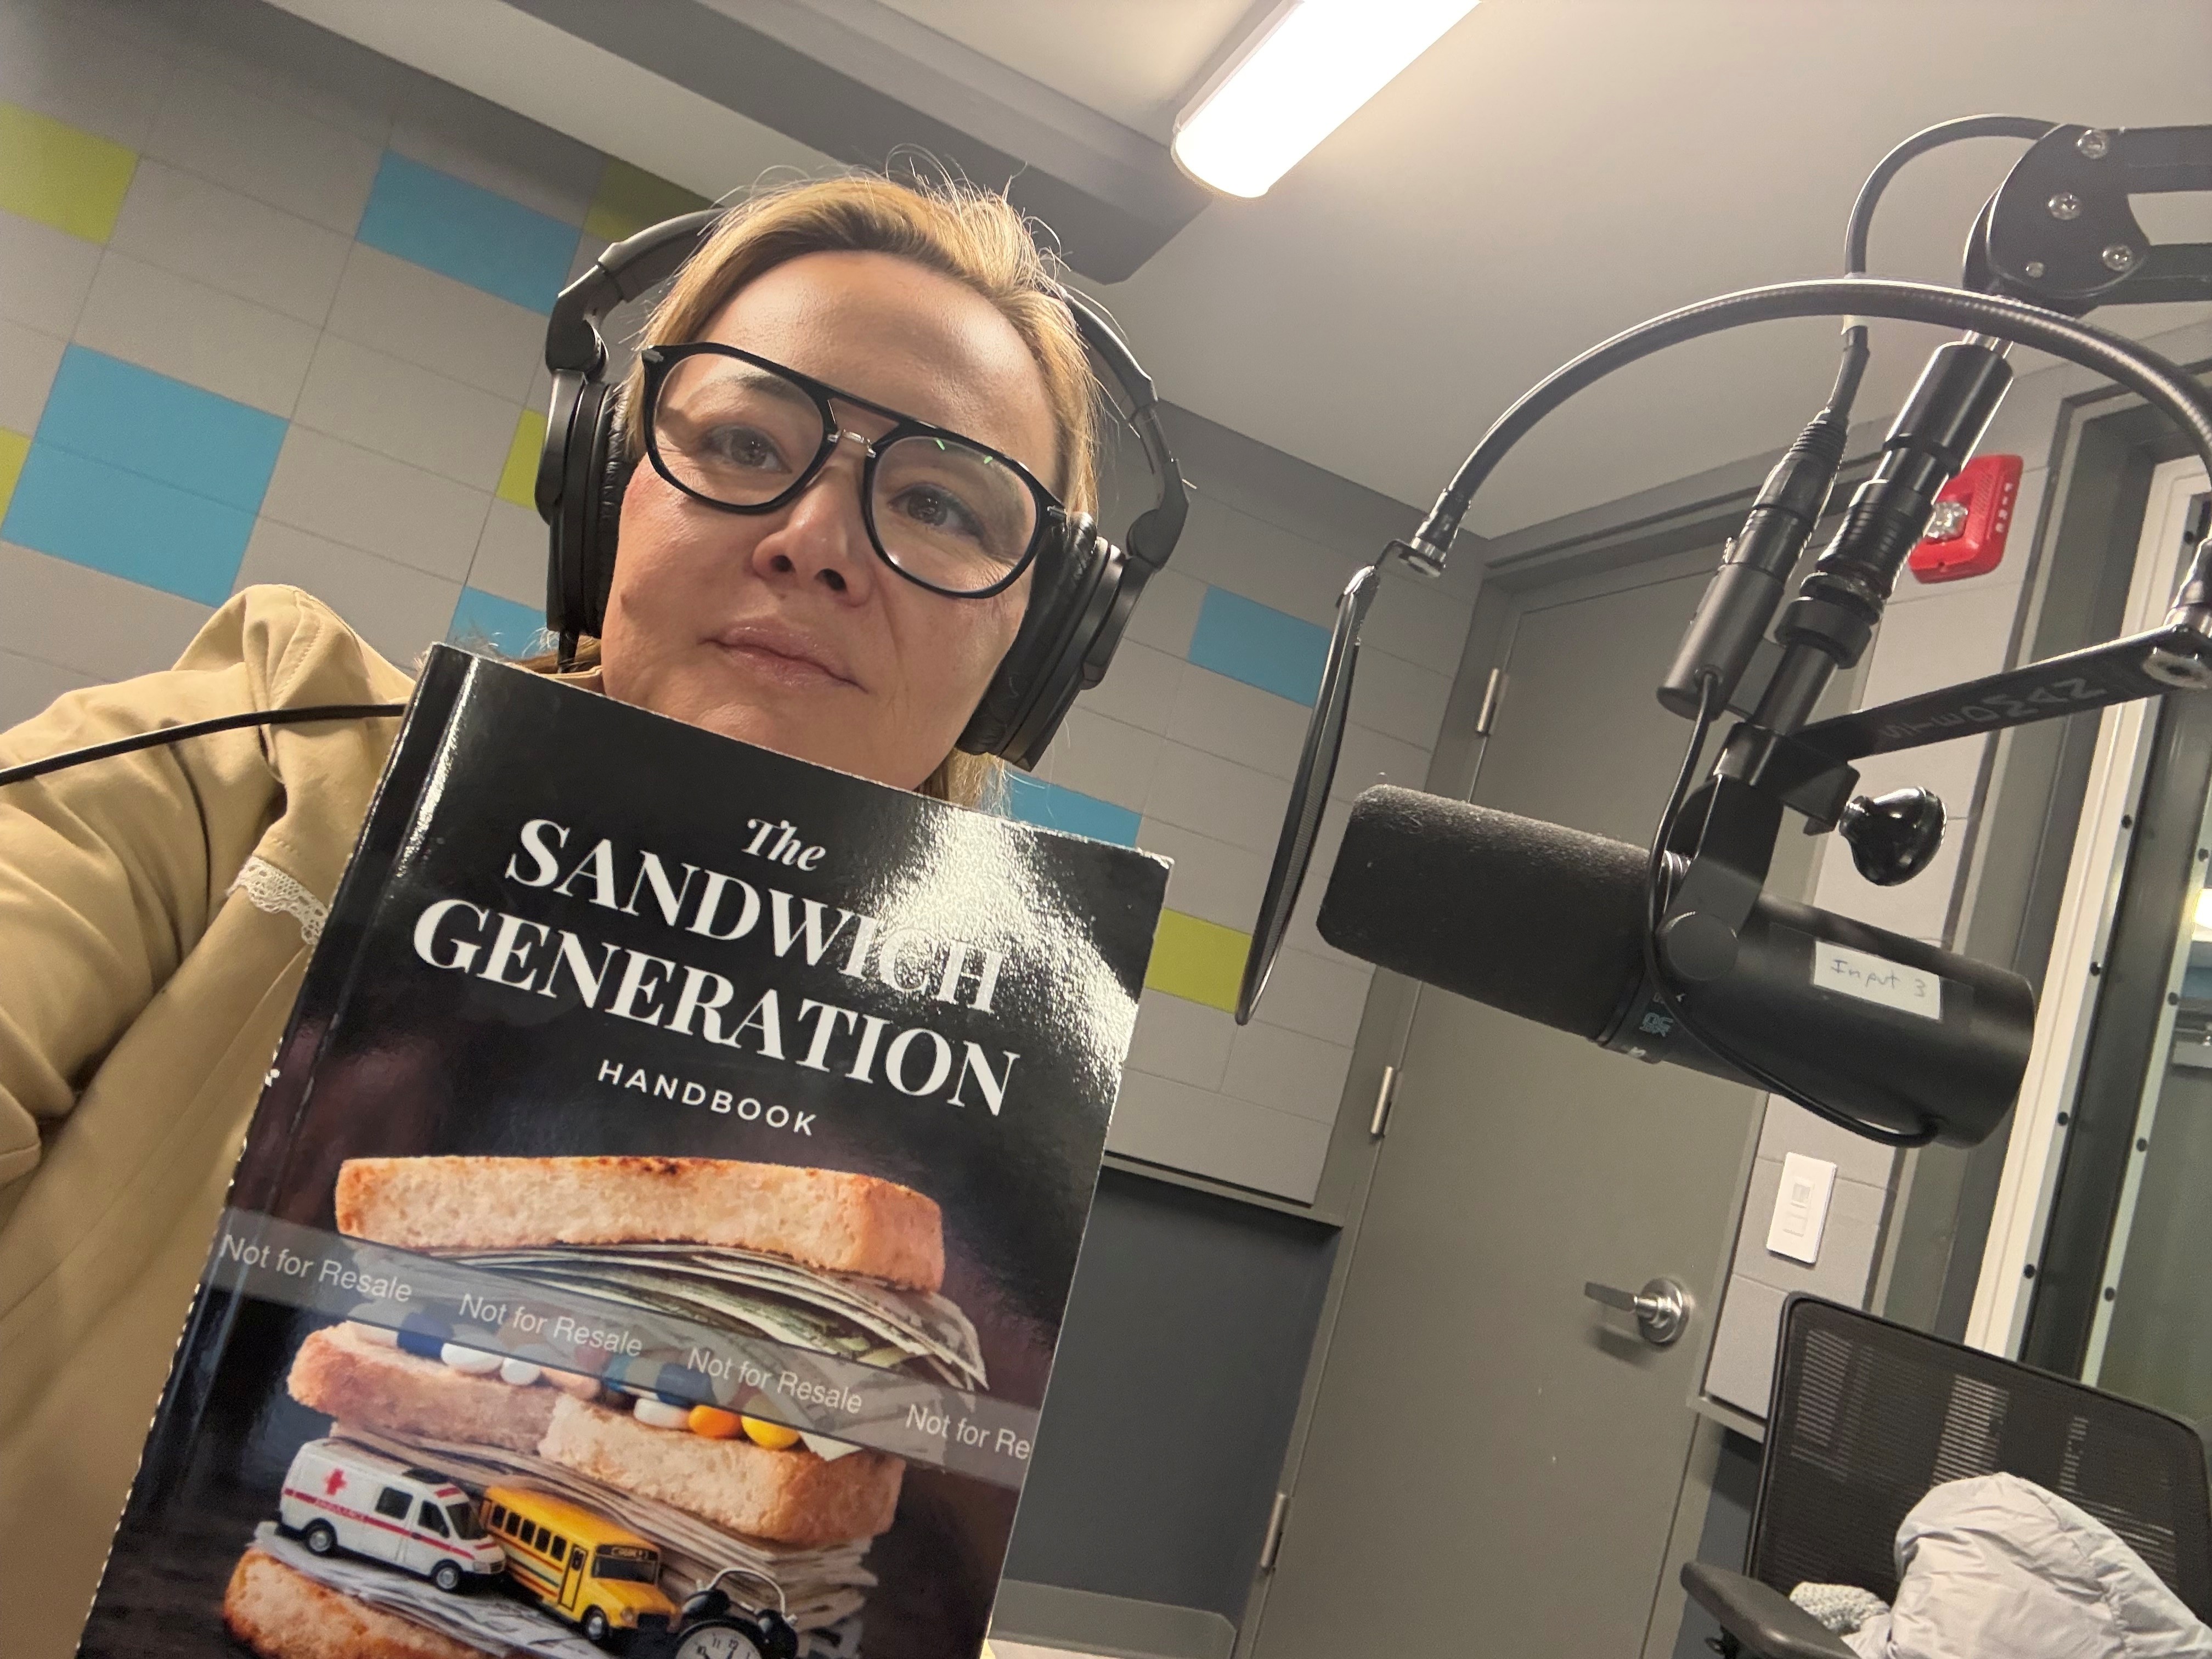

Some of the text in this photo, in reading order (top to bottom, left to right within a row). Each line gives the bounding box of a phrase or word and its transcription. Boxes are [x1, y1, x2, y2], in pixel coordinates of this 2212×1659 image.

[742, 818, 827, 872] The
[505, 819, 1004, 1014] SANDWICH
[1831, 960, 1926, 997] Input 3
[413, 899, 1020, 1116] GENERATION
[597, 1059, 817, 1136] HANDBOOK
[219, 1234, 1031, 1460] Not for Resale Not for Resale Not for Resale Not for Re
